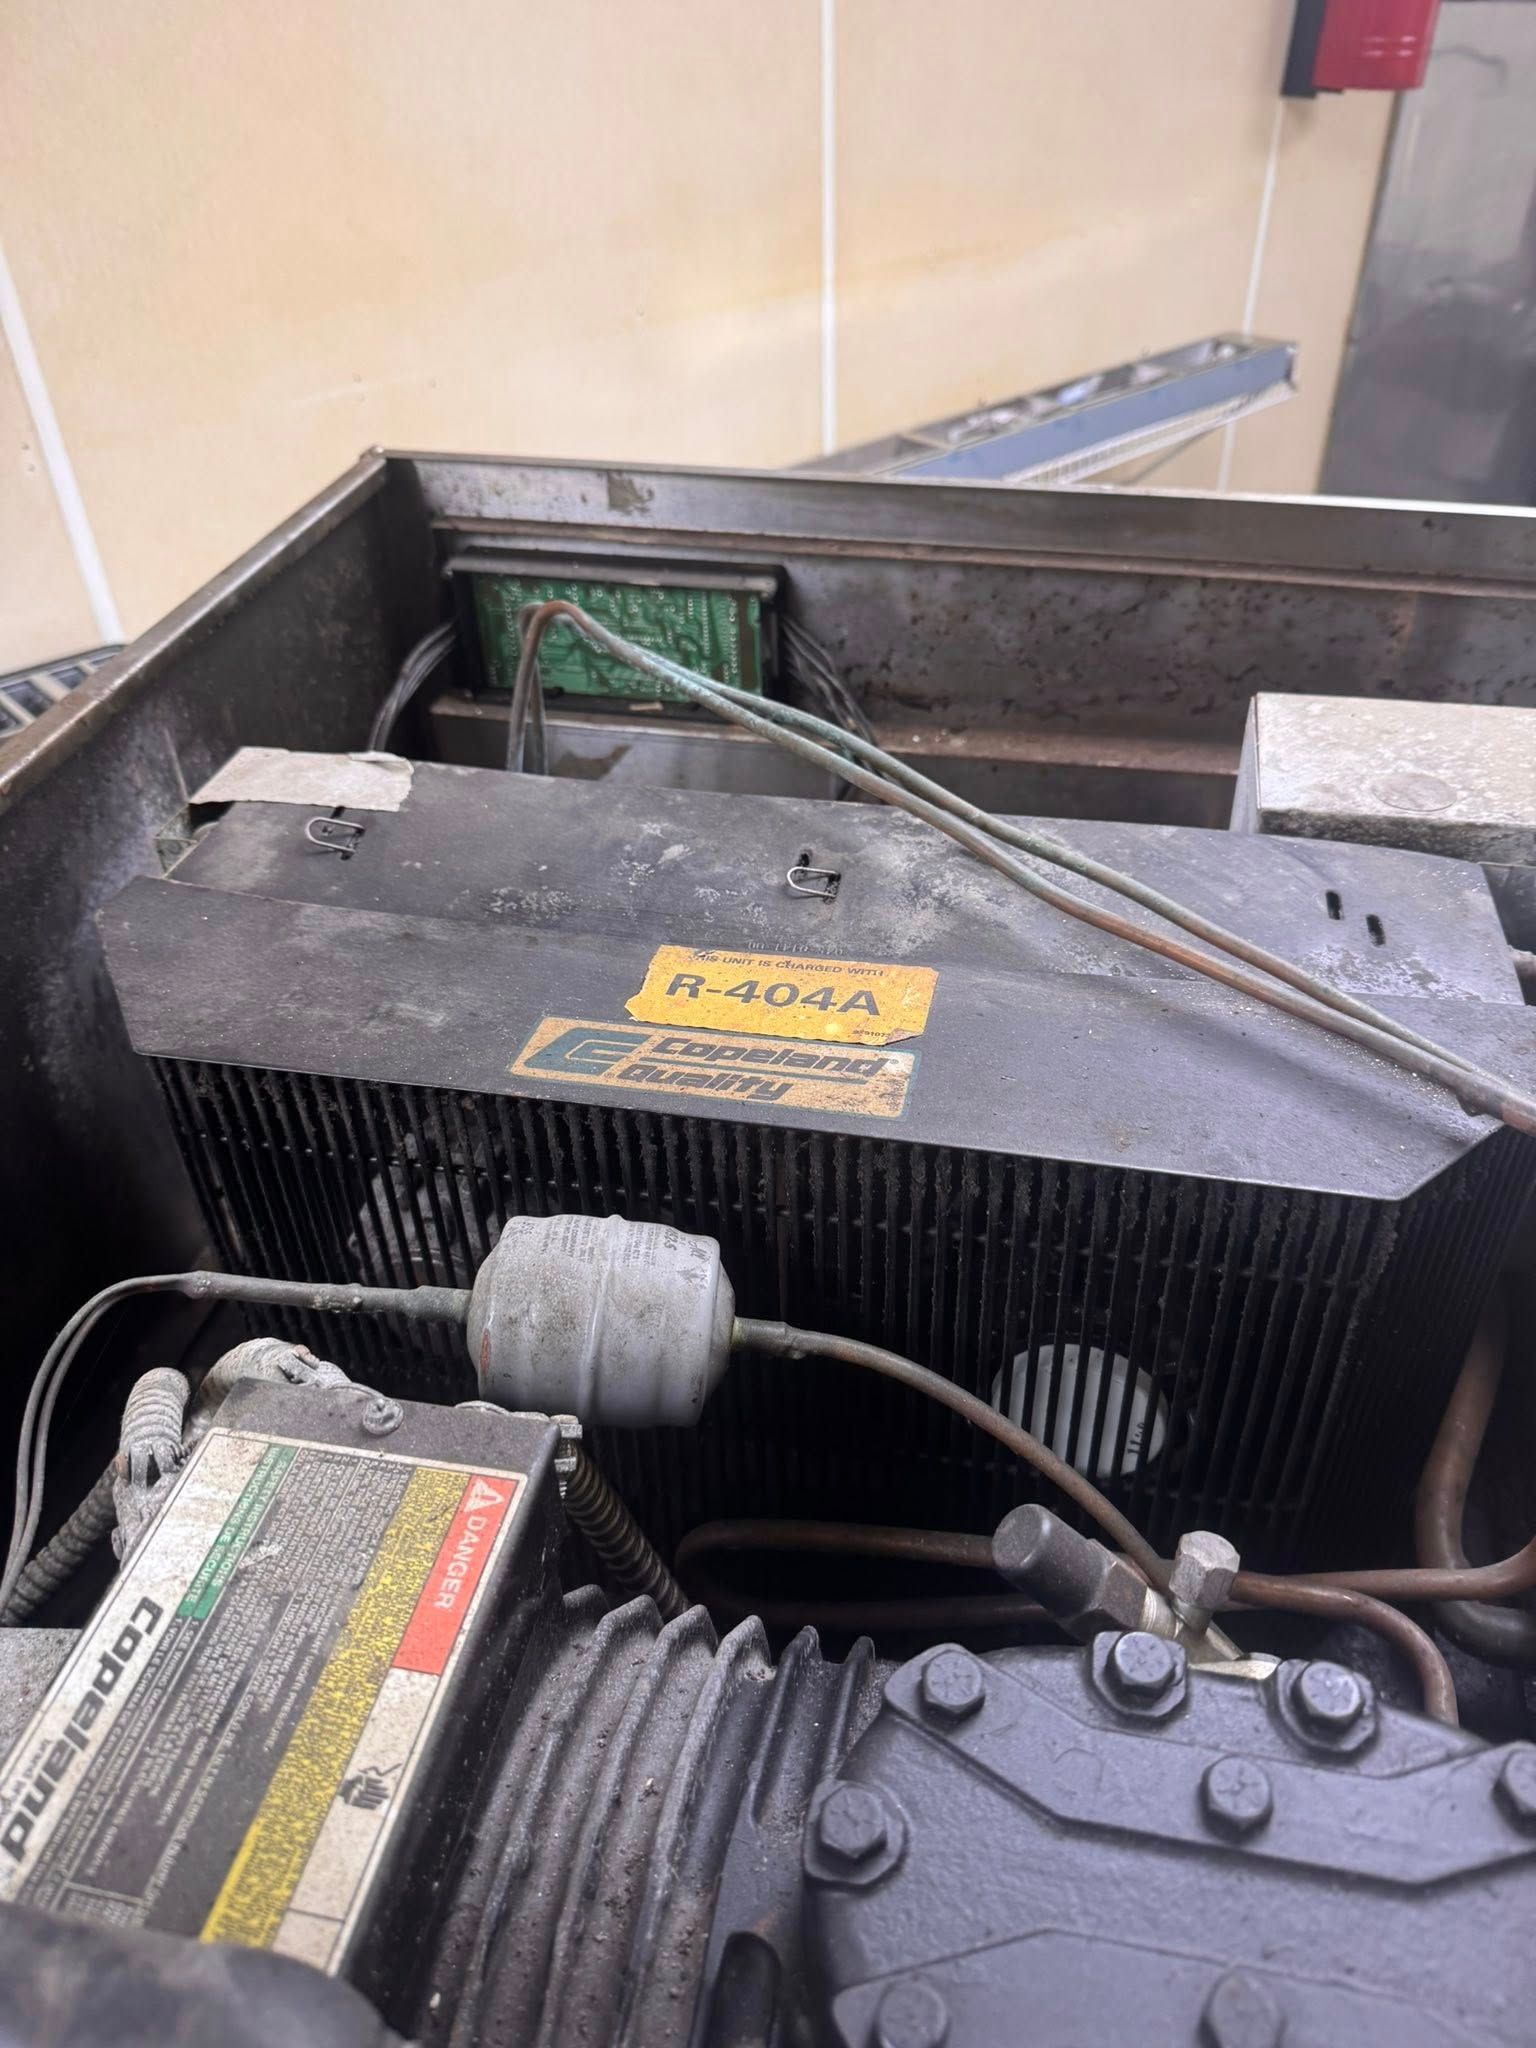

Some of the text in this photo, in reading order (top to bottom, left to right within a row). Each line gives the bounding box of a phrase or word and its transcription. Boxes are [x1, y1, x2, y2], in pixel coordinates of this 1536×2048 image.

[688, 954, 719, 962] HIS
[723, 957, 754, 966] UNIT
[775, 961, 843, 973] CHARGED
[848, 967, 884, 977] WITH
[666, 973, 881, 1016] R-404A
[651, 1037, 890, 1077] Copeland
[617, 1063, 793, 1100] Quality
[433, 1512, 488, 1611] DANGER
[0, 1597, 164, 1864] Copeland
